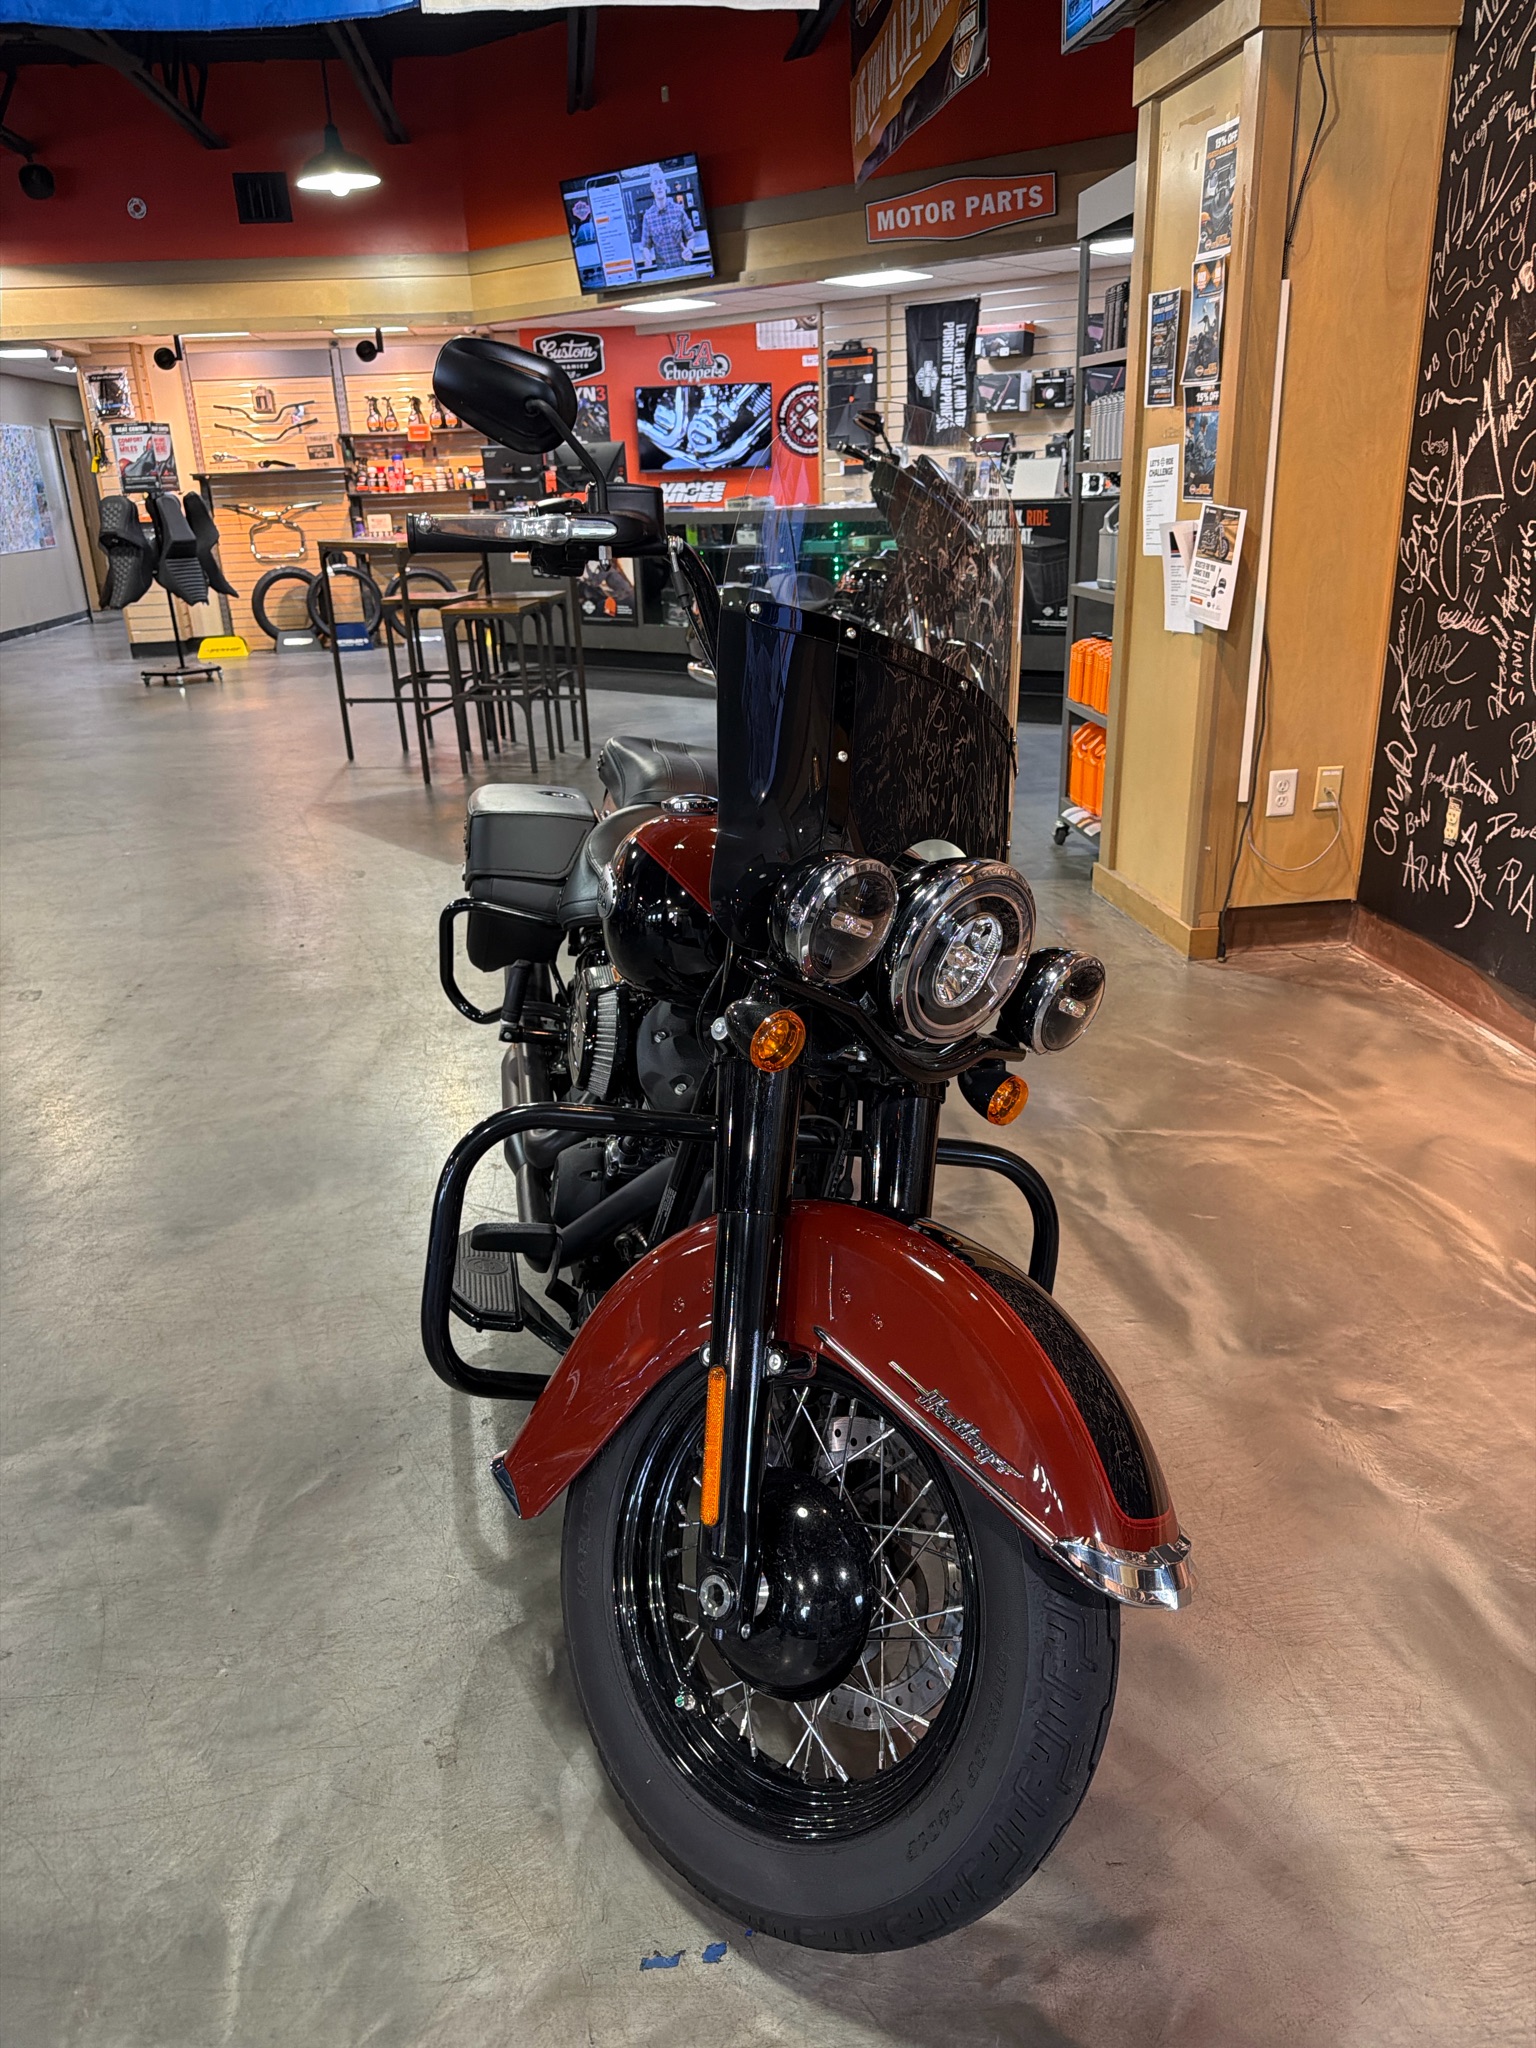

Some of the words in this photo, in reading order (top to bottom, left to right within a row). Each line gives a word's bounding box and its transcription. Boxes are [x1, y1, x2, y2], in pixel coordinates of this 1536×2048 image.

[877, 200, 955, 232] MOTOR
[965, 185, 1043, 218] PARTS
[942, 321, 955, 363] PURSUIT
[955, 323, 967, 346] LIFE,
[540, 340, 597, 363] Custom
[675, 333, 714, 367] LA
[942, 364, 953, 377] OF
[953, 348, 966, 388] LIBERTY,
[954, 389, 967, 410] AND
[1196, 392, 1209, 402] 15%
[1209, 390, 1219, 402] OFF
[120, 445, 138, 453] MILES
[1149, 467, 1174, 477] CHALLENGE
[660, 481, 727, 493] VANCE
[1026, 509, 1051, 527] RIDE.
[1508, 629, 1530, 706] SANDY
[1402, 841, 1452, 894] ARIA
